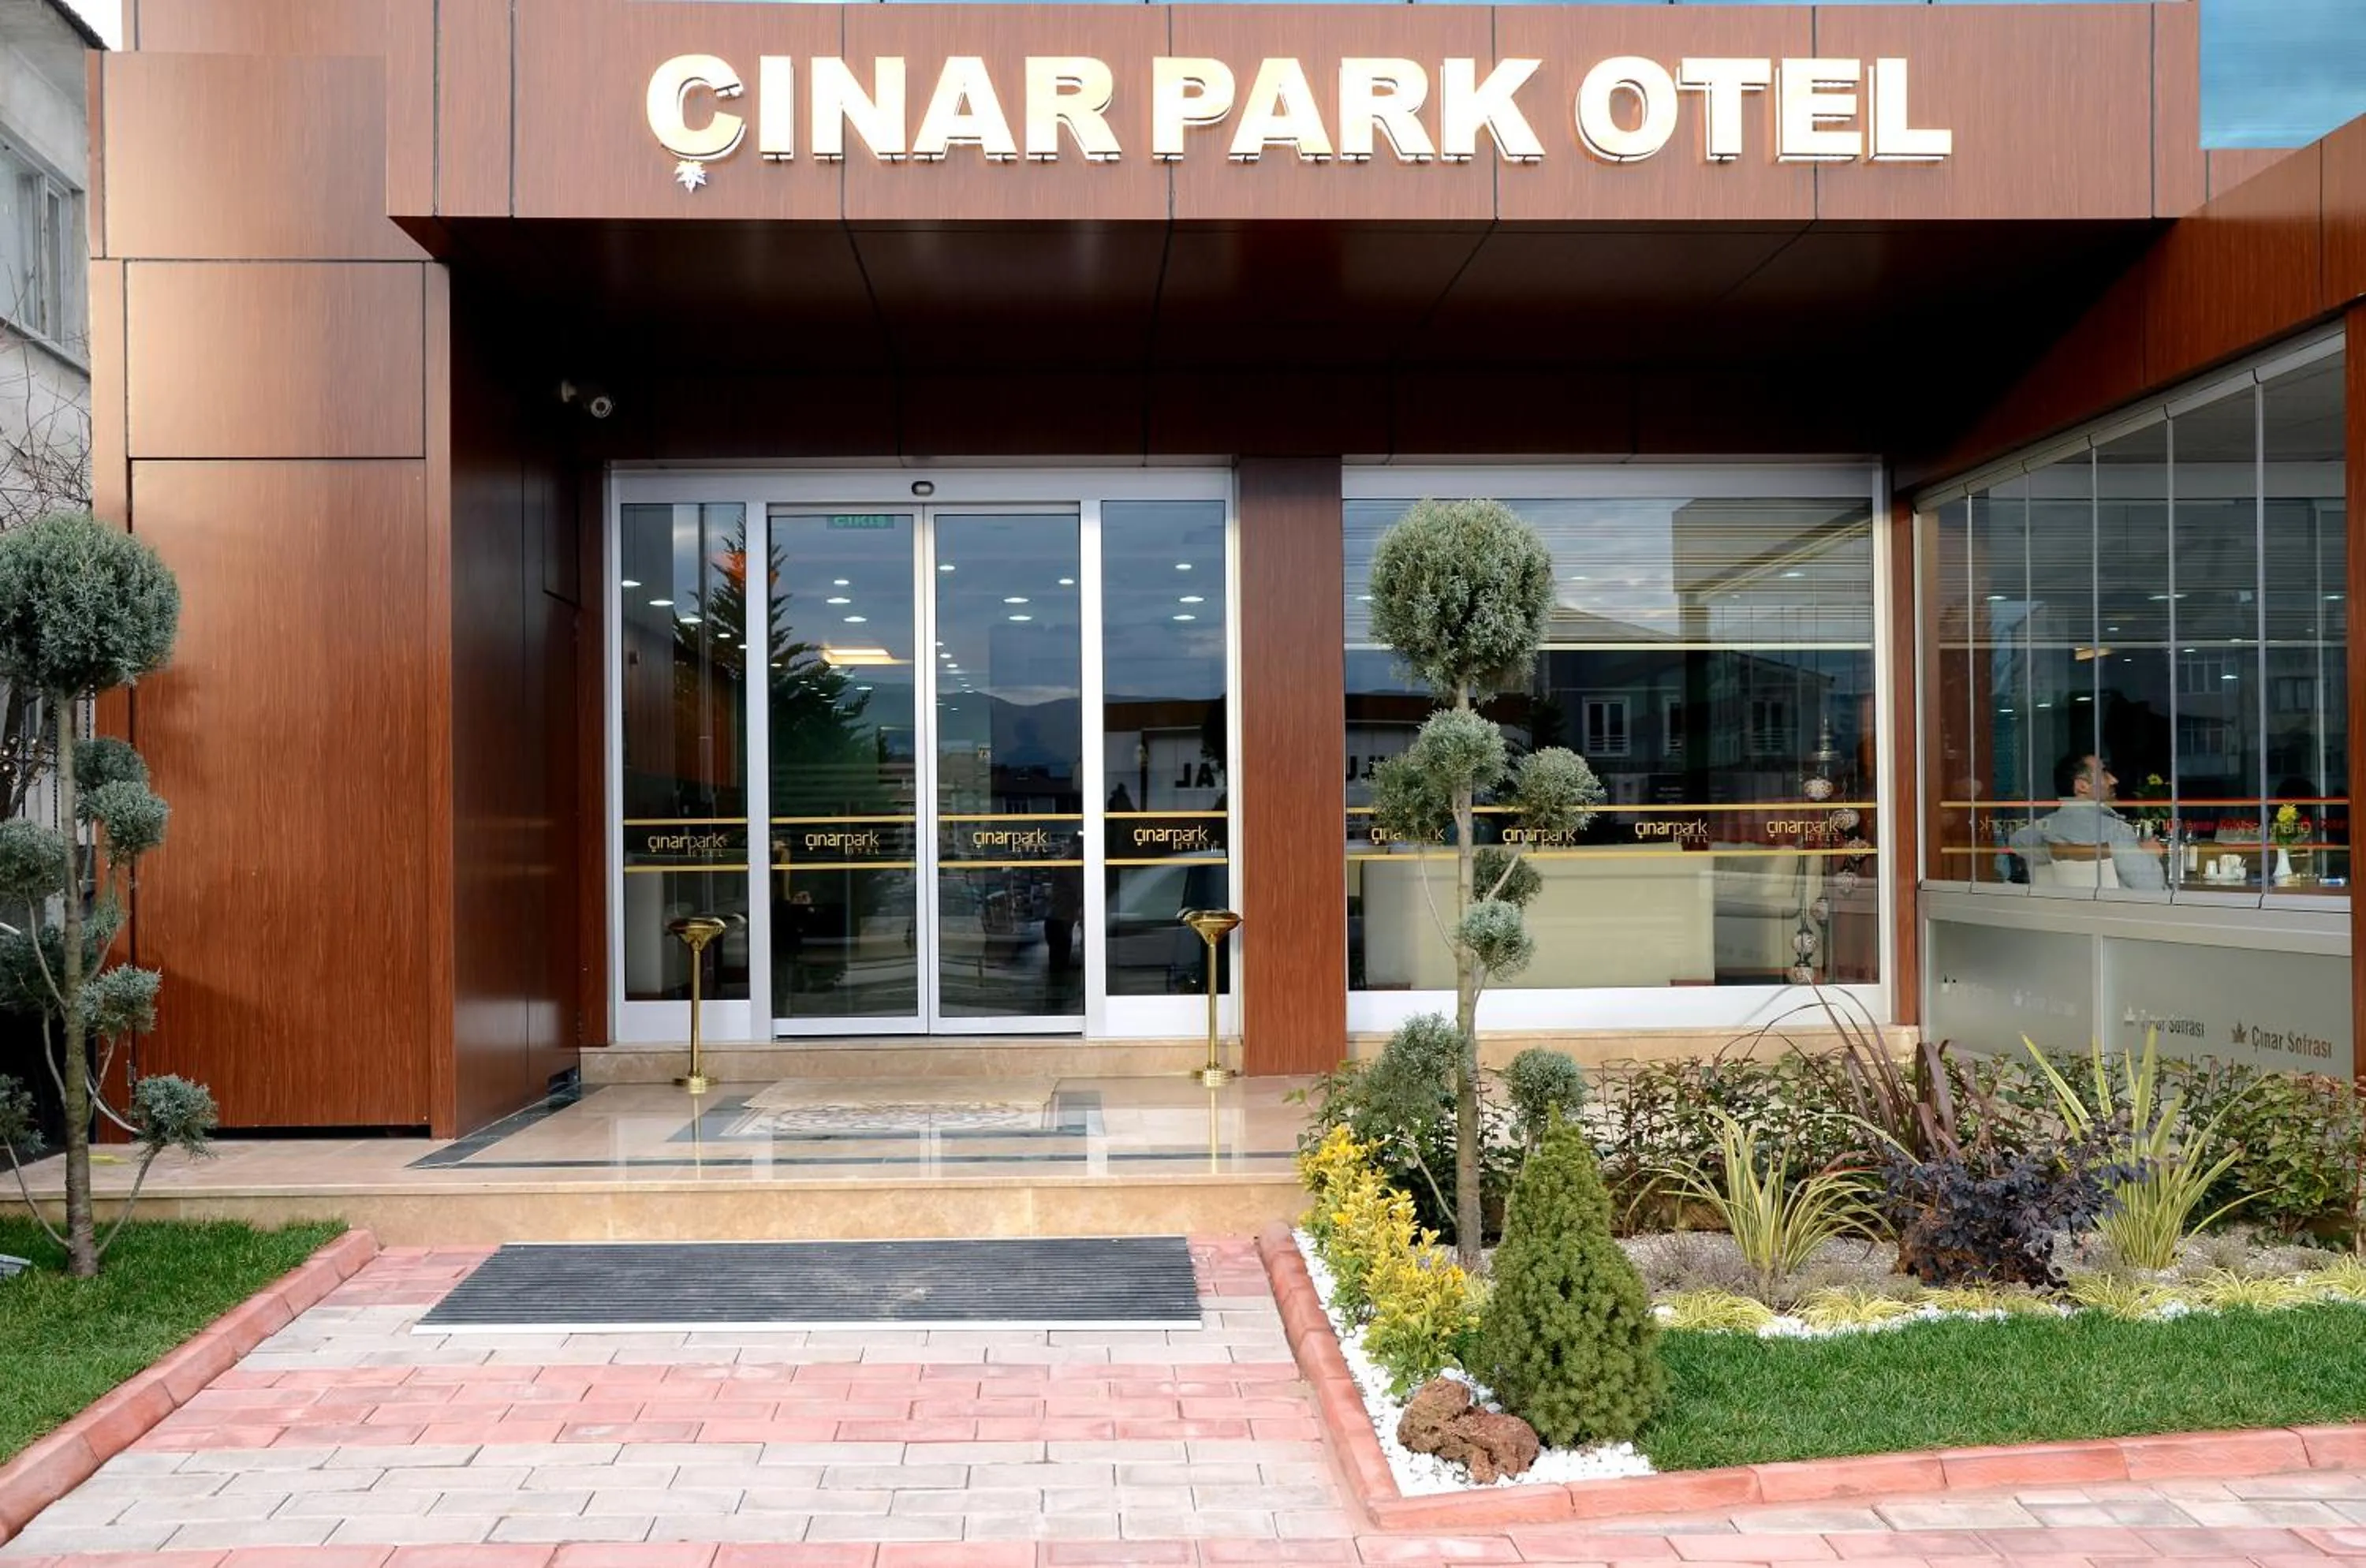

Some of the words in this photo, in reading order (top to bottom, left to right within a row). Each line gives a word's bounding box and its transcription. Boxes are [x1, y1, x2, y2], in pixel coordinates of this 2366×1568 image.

[646, 54, 1121, 192] ÇINAR
[1152, 56, 1546, 161] PARK
[1575, 55, 1953, 162] OTEL
[2251, 1025, 2284, 1052] Çınar
[2287, 1031, 2333, 1059] Sofrası
